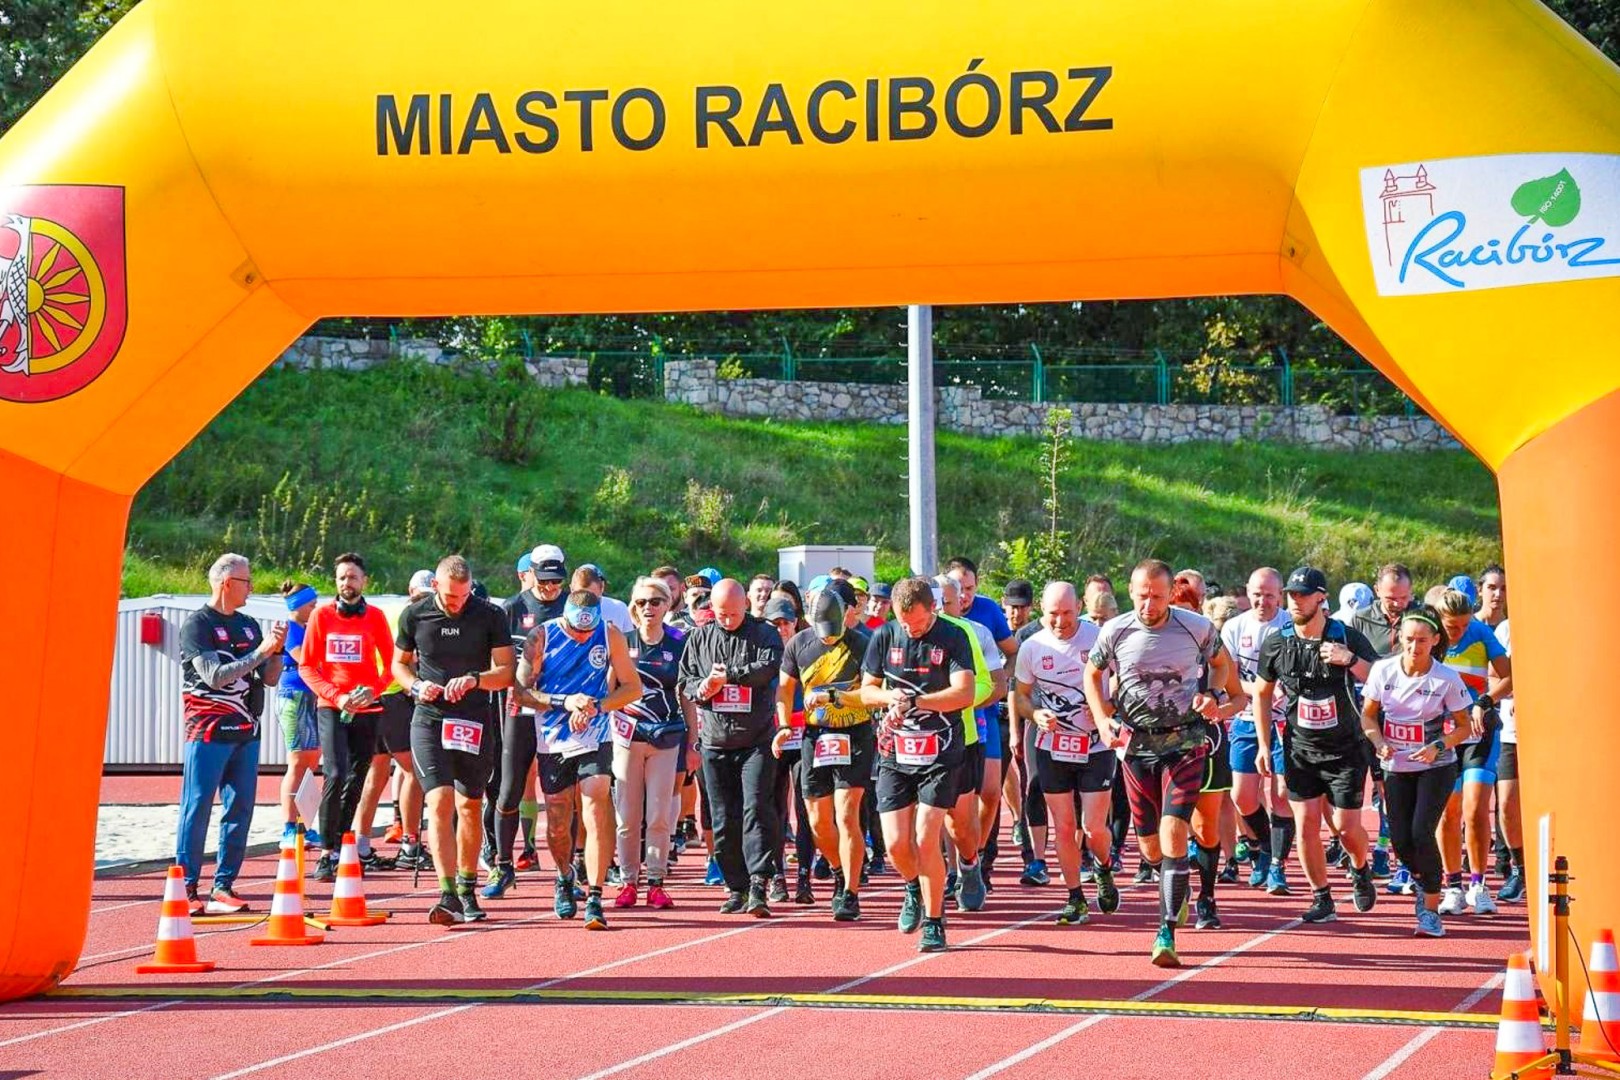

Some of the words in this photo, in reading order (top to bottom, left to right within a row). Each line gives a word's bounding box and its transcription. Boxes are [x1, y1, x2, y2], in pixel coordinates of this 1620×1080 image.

[377, 87, 666, 156] MIASTO
[696, 58, 1113, 149] RACIBÓRZ
[1539, 200, 1553, 214] ISO
[1551, 179, 1567, 202] 14001
[1399, 210, 1620, 288] Racibórz
[441, 628, 460, 636] RUN
[333, 641, 356, 653] 112
[723, 687, 740, 702] 18
[1301, 704, 1332, 720] 103
[453, 724, 474, 742] 82
[1389, 724, 1416, 740] 101
[819, 740, 840, 755] 32
[904, 738, 928, 754] 87
[1058, 736, 1081, 752] 66
